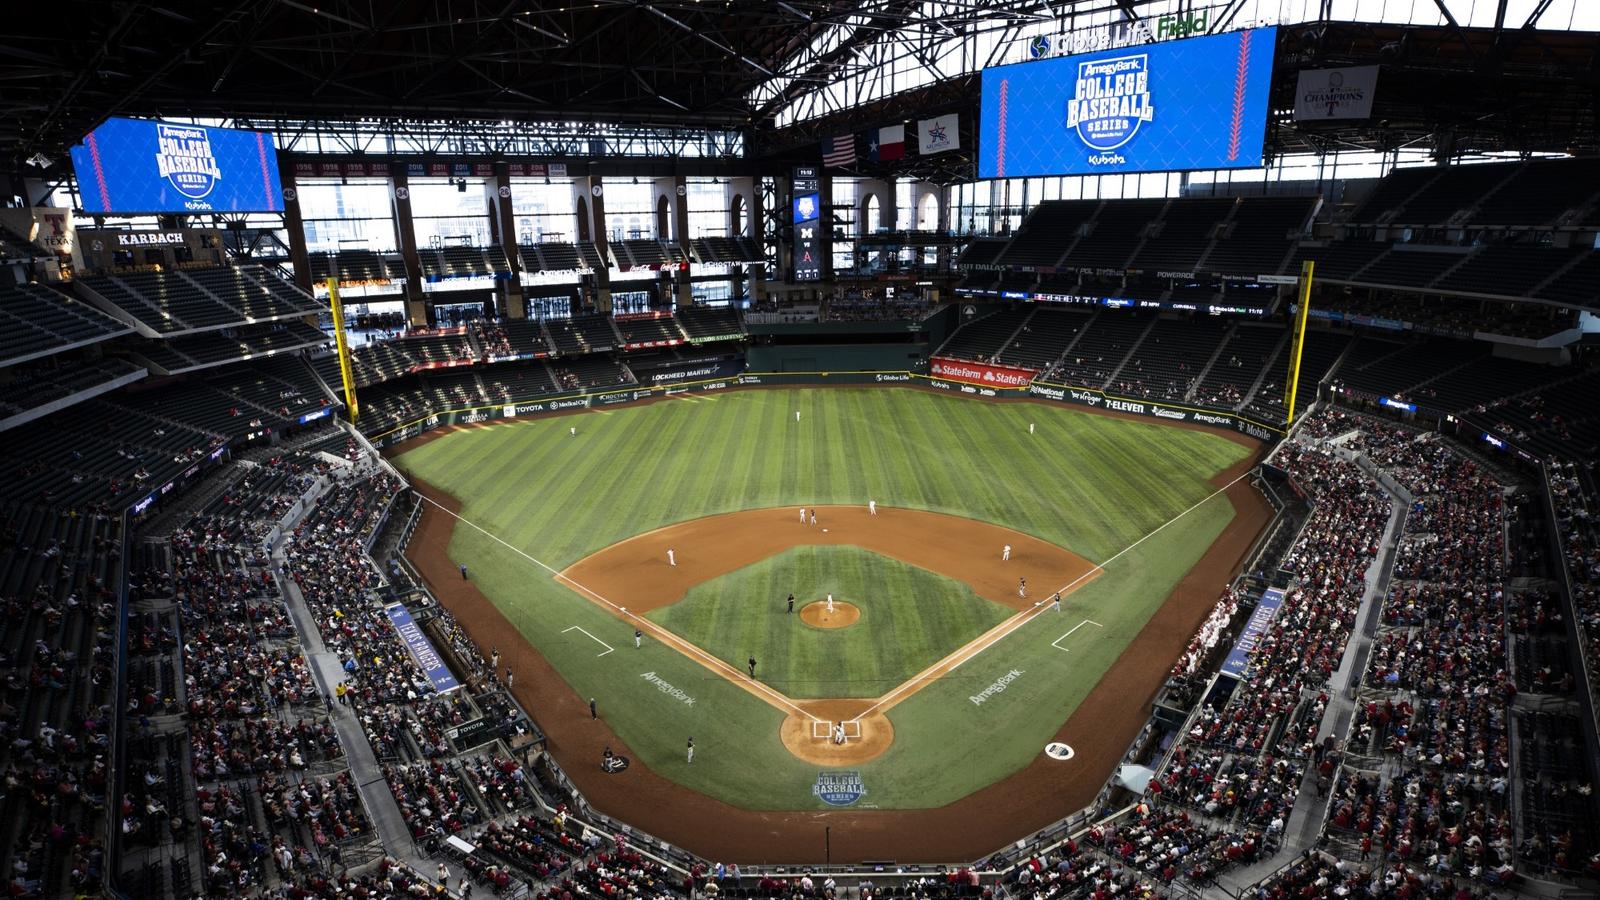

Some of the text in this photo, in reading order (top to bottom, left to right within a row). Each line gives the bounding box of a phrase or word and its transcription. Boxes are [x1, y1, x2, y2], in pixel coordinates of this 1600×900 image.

[1115, 20, 1151, 45] Life
[1157, 10, 1208, 39] Field
[1076, 71, 1147, 101] COLLEGE
[1304, 92, 1364, 103] CHAMPIONS
[1067, 92, 1153, 128] BASEBALL
[1087, 120, 1129, 132] SERIES
[159, 138, 212, 158] COLLEGE
[1088, 154, 1126, 165] Kubota
[157, 154, 221, 179] BASEBALL
[177, 174, 207, 183] SERIES
[118, 233, 183, 245] KARBACH
[576, 267, 595, 275] Bank
[975, 263, 1006, 271] DALLAS
[1157, 271, 1195, 279] POWERADE
[652, 369, 711, 381] LOCKHEED MARTIN
[995, 373, 1032, 386] StateFar
[1038, 386, 1065, 397] National
[1079, 391, 1102, 406] Kroger
[515, 404, 544, 413] TOYOTA
[1246, 423, 1271, 440] Mobile
[1248, 605, 1275, 631] RANGERS
[400, 622, 442, 672] TEXAS RANGERS
[459, 721, 484, 735] TOYOTA
[818, 776, 861, 786] COLLEGE
[814, 784, 867, 795] BASEBALL
